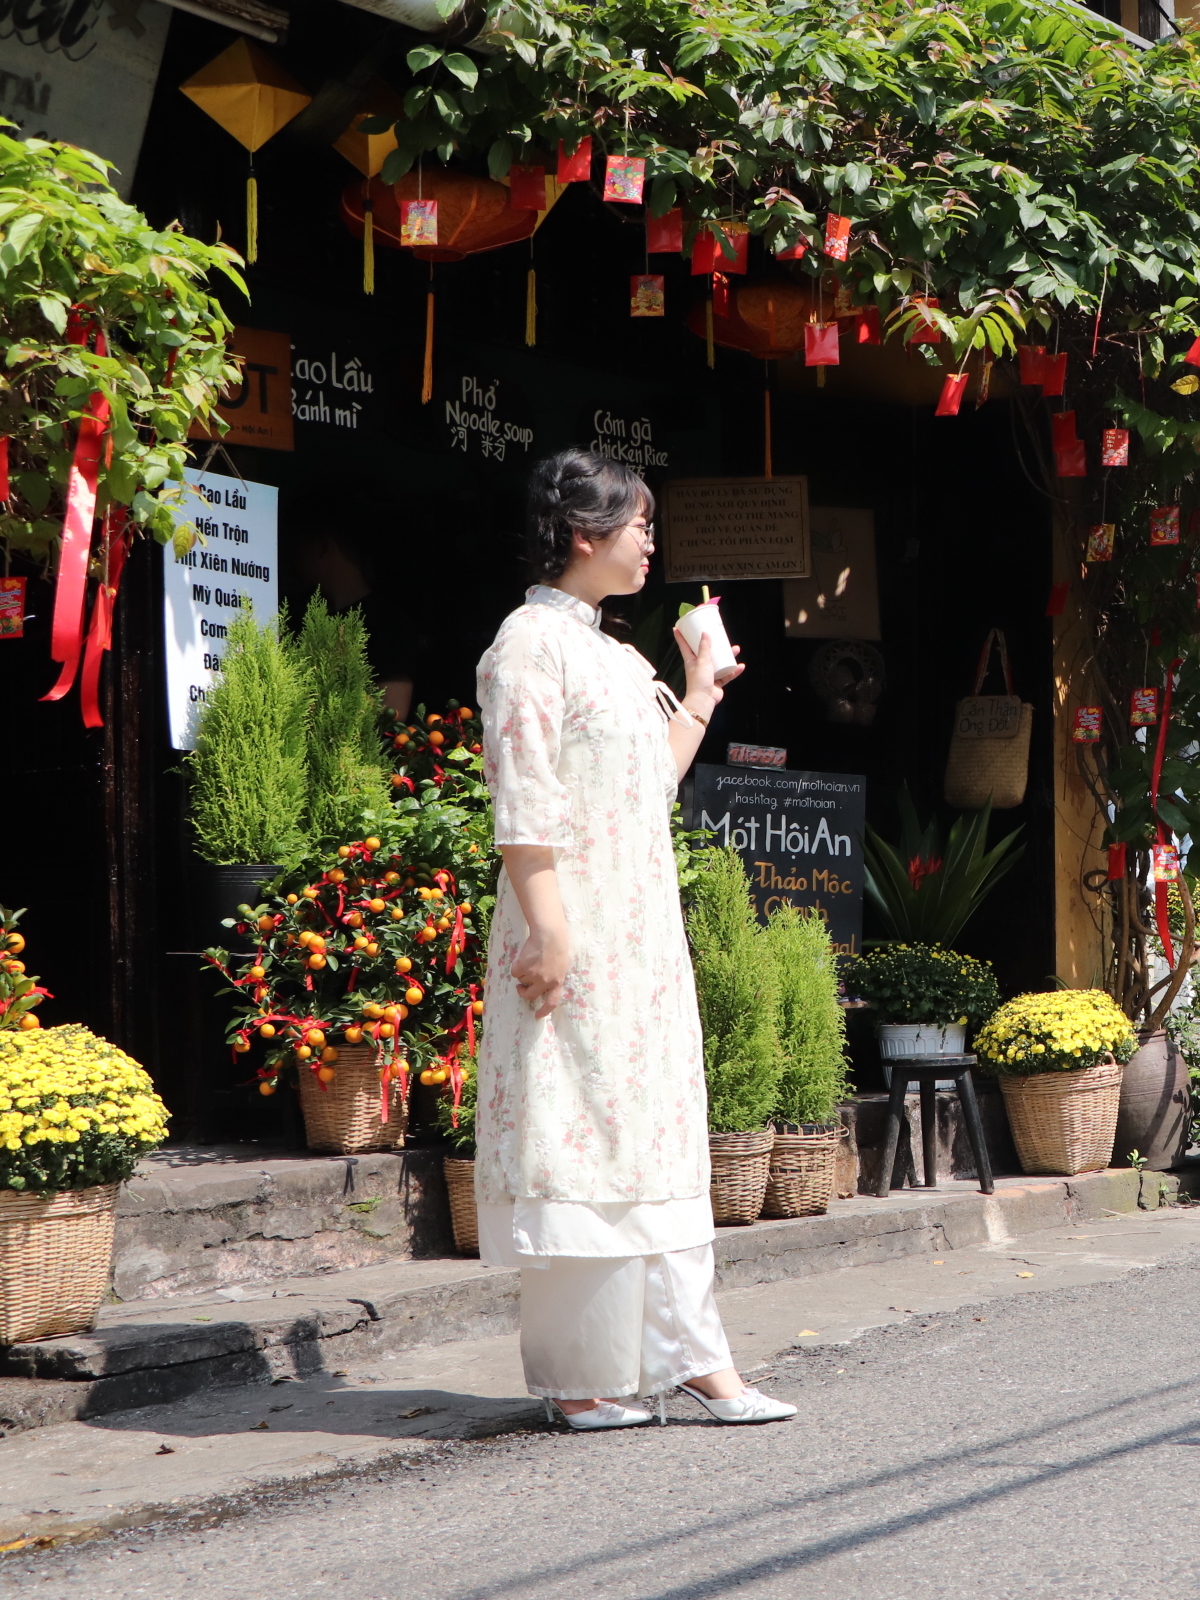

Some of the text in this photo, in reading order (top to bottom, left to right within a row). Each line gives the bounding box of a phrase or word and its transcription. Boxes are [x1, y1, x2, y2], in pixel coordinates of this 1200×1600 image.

[331, 352, 374, 393] Lầu
[335, 402, 362, 429] mì
[445, 400, 533, 452] Noodle soup
[645, 445, 669, 467] Rice
[198, 484, 247, 510] Cao Lầu
[768, 510, 799, 520] MANG
[195, 516, 249, 545] Hến Trộn
[200, 551, 228, 573] Xiên
[232, 557, 270, 582] Nướng
[737, 561, 755, 571] XIN
[193, 584, 253, 610] Mỳ Quả
[960, 718, 984, 736] Ong
[735, 792, 836, 810] hashtag #mothoian
[701, 810, 852, 860] Mót Hội An
[753, 861, 853, 899] Thảo Mộc
